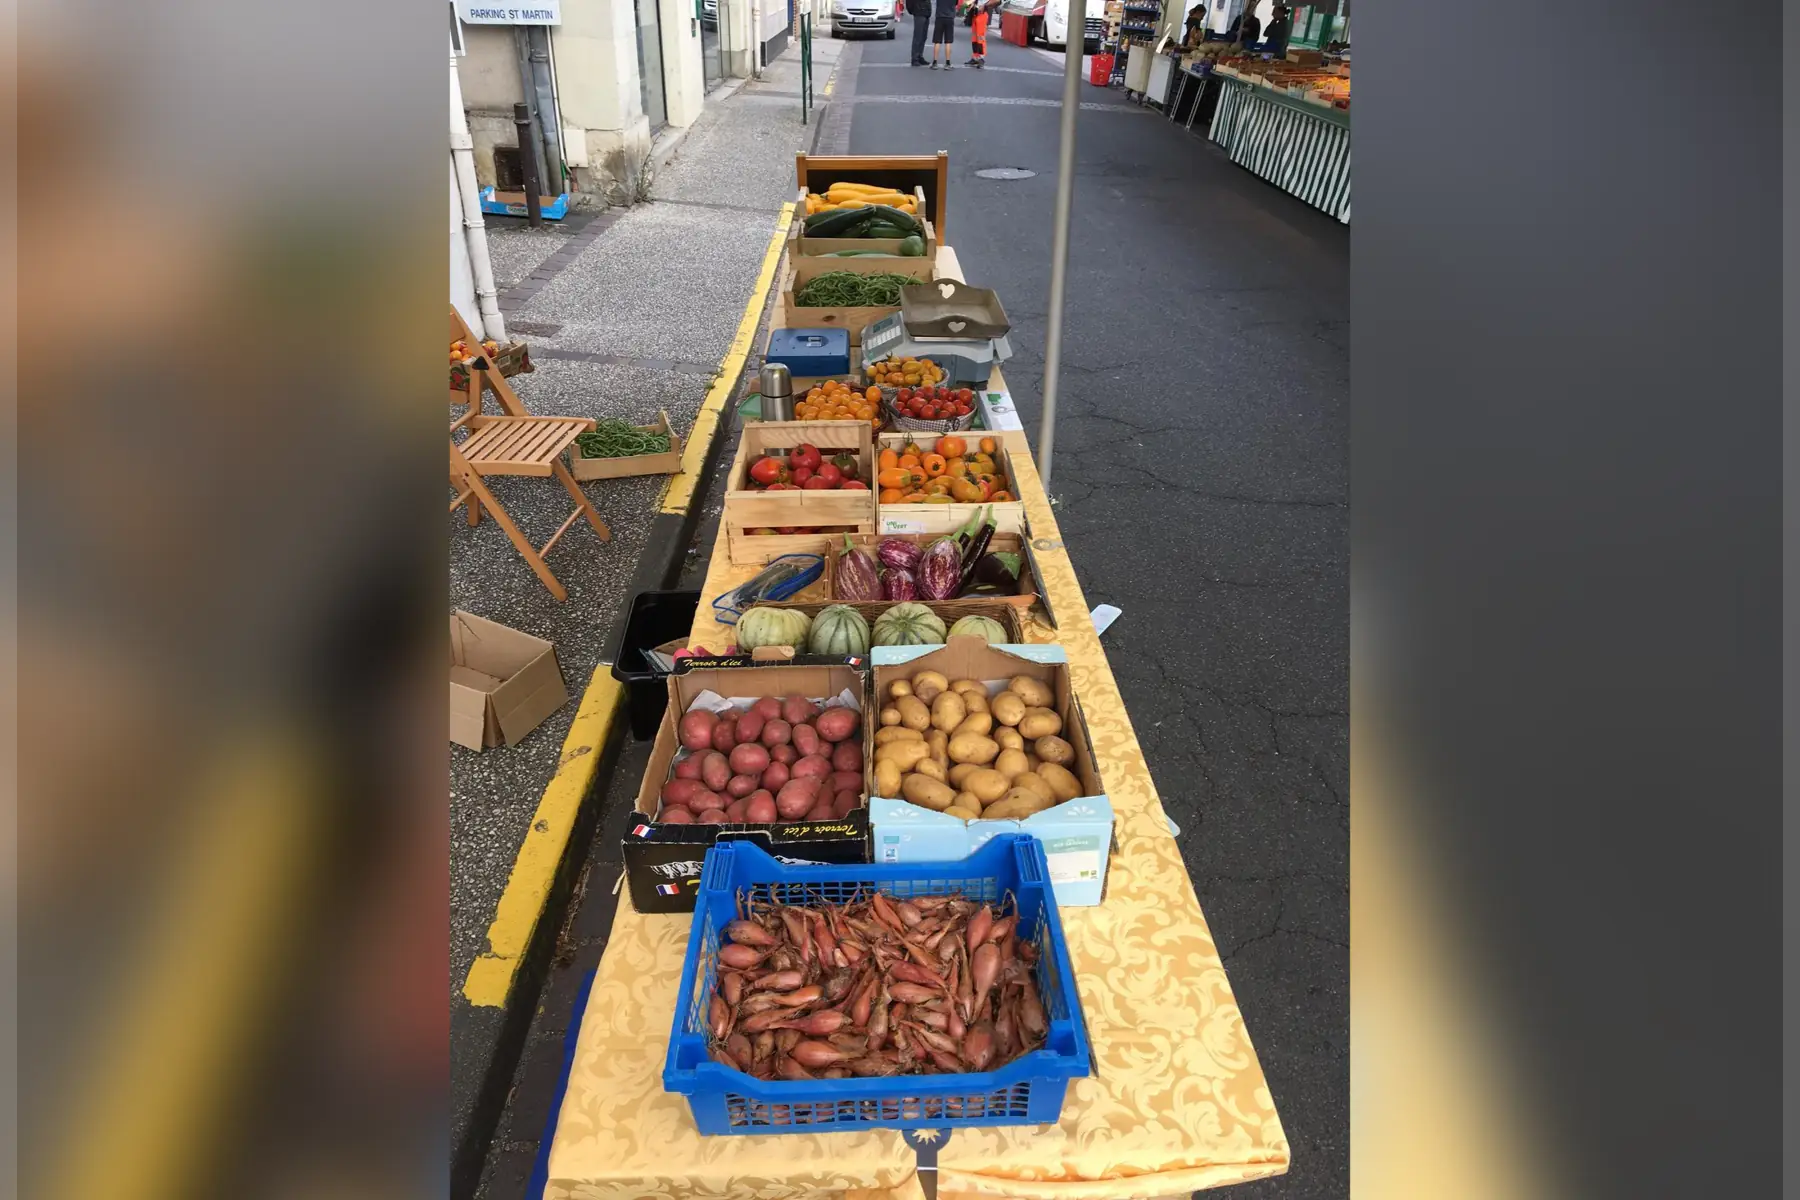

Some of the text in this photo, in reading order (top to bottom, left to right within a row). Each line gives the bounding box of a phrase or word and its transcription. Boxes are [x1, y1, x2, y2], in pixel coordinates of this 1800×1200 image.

[470, 9, 553, 19] PARKING ST MARTIN
[683, 658, 743, 667] Terroir d'ici
[782, 824, 857, 838] Terroir d'ici
